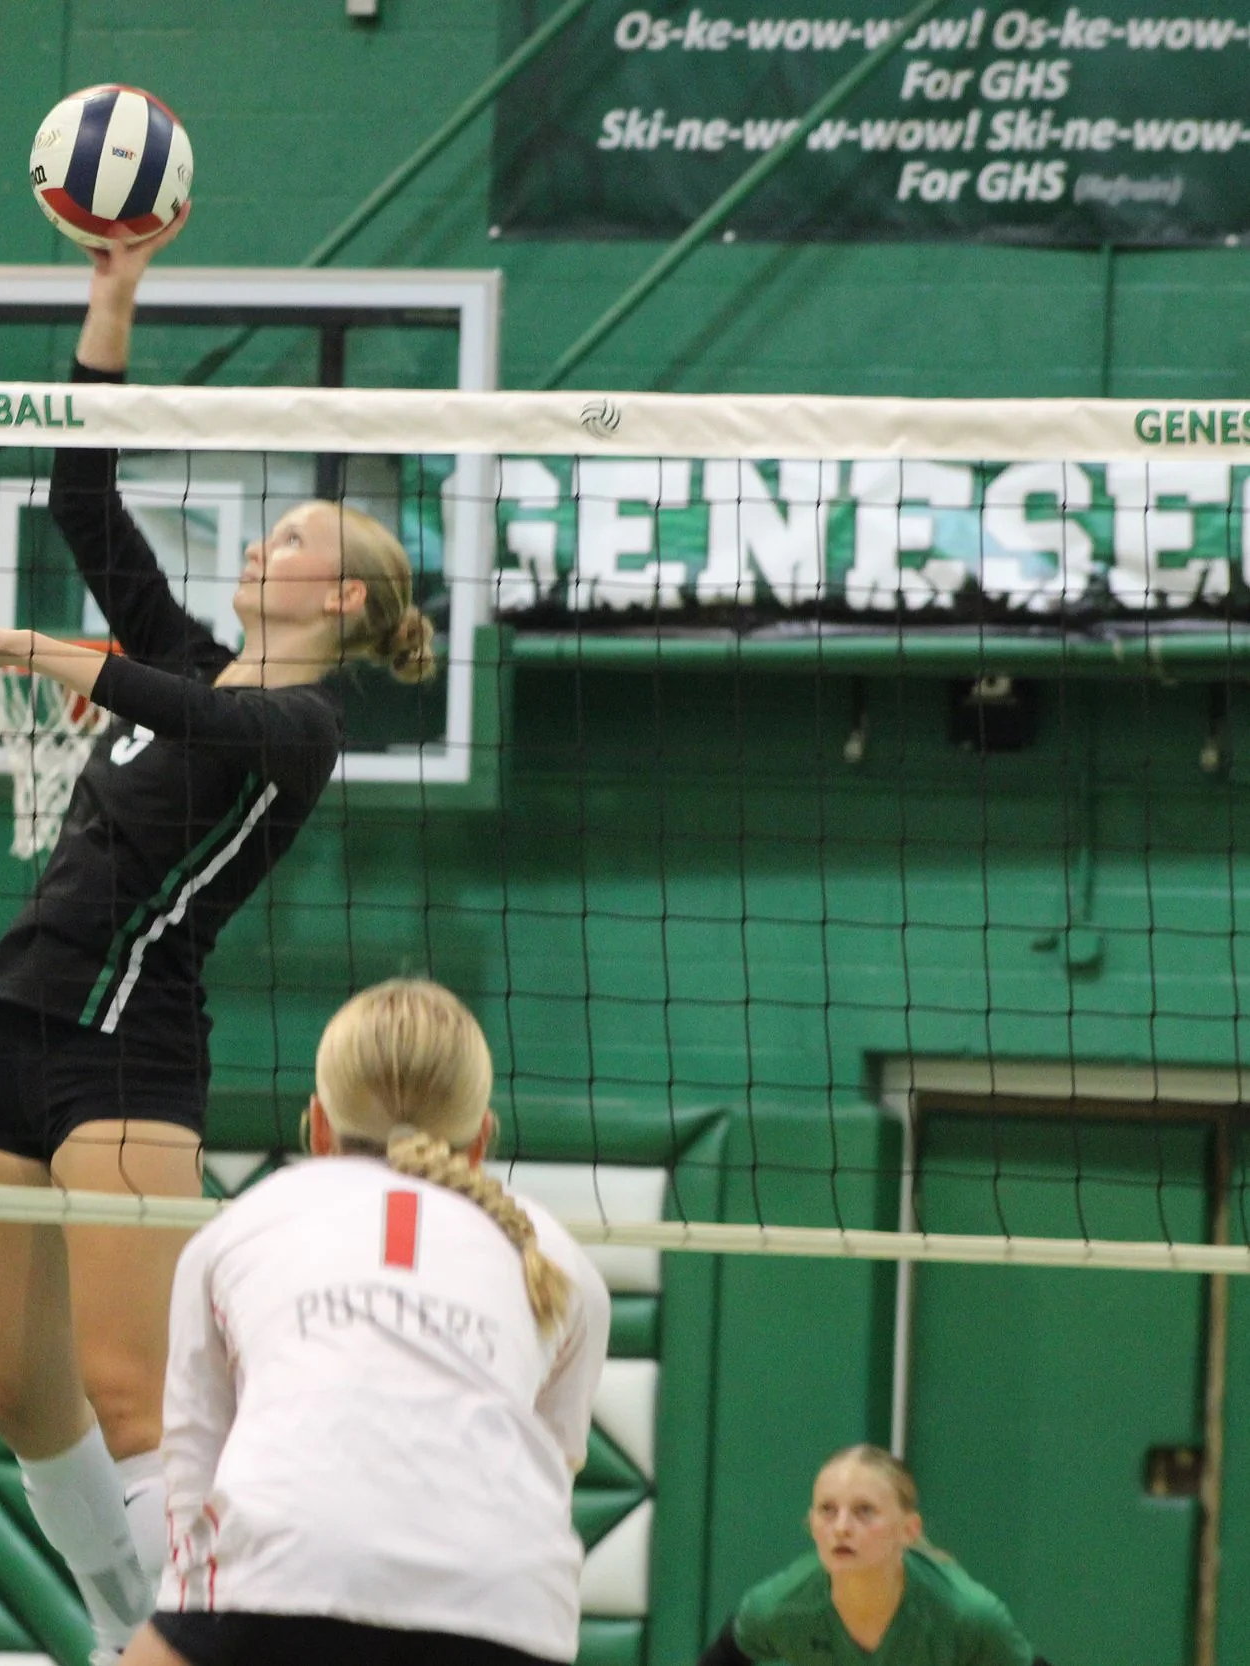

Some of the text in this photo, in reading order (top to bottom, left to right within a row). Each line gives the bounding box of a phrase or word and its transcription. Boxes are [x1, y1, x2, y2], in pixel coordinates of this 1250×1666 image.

[900, 60, 1072, 101] For GHS
[897, 161, 971, 201] For
[976, 160, 1068, 201] GHS
[441, 459, 1250, 614] GENESE
[381, 1189, 422, 1271] 1
